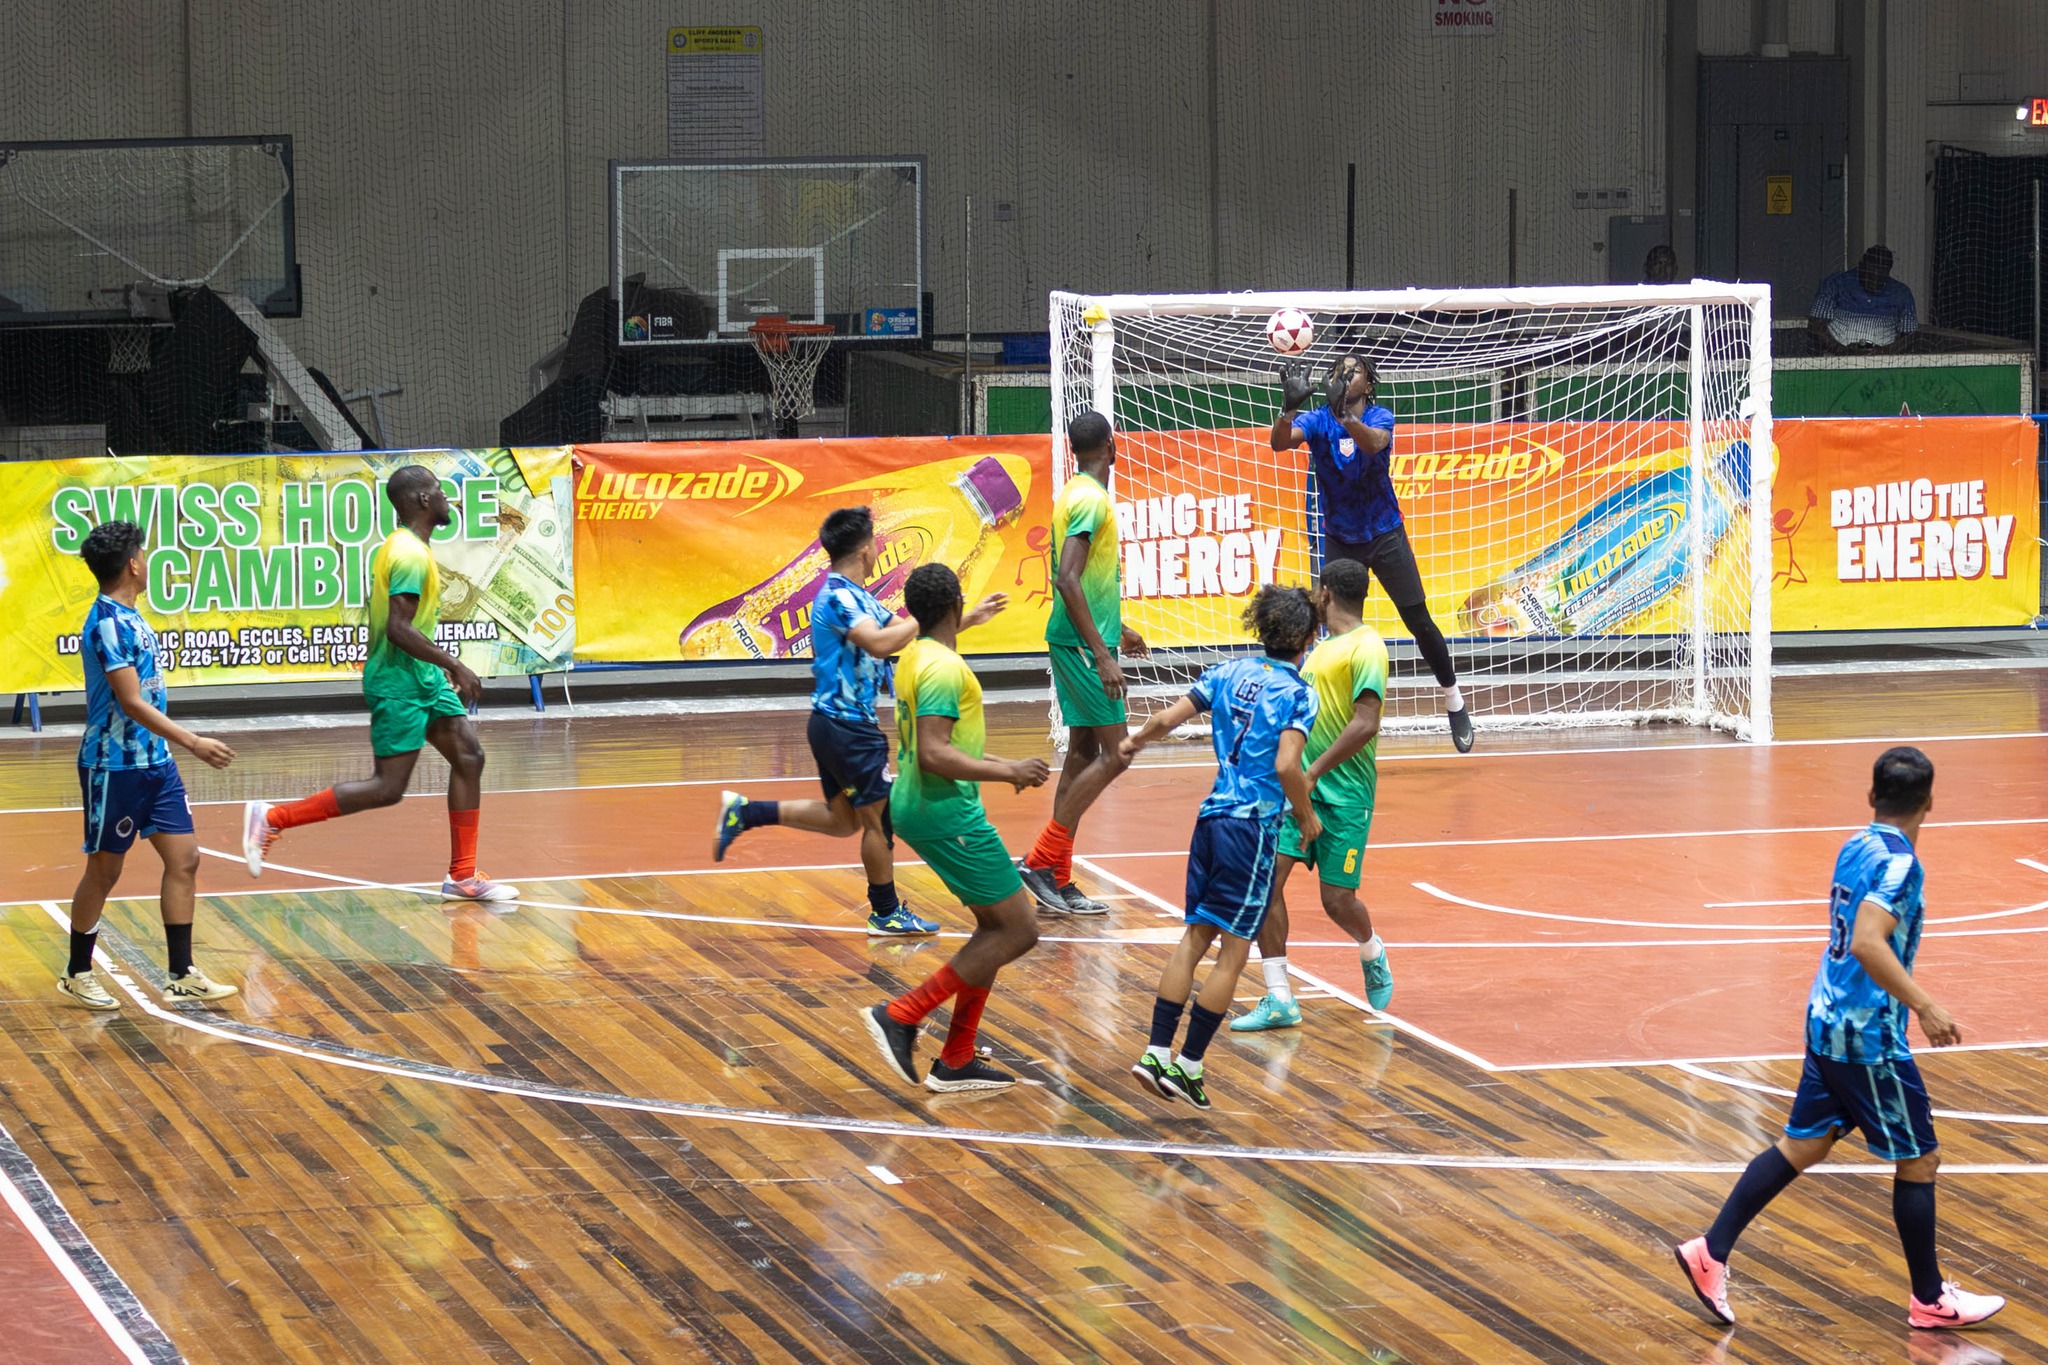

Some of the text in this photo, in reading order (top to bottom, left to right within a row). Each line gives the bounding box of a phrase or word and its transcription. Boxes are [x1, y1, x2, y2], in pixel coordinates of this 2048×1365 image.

[1435, 11, 1494, 27] SMOKING
[2032, 98, 2048, 125] EX
[654, 316, 673, 327] FIBA
[576, 463, 769, 500] Lucozade
[52, 482, 262, 555] SWISS
[1115, 493, 1252, 540] RING THE
[1831, 478, 1985, 528] BRING THE
[1120, 528, 1282, 599] NERGY
[1837, 515, 2014, 581] ENERGY
[147, 542, 383, 615] CAMBI
[58, 634, 82, 654] LO
[184, 630, 234, 651] ROAD,
[240, 627, 308, 648] ECCLES,
[313, 626, 354, 644] EAST
[181, 647, 262, 667] 226-1723
[266, 649, 284, 665] or
[287, 645, 326, 663] Cell:
[330, 644, 368, 666] (592
[1230, 703, 1255, 768] 7
[1343, 848, 1359, 874] 6
